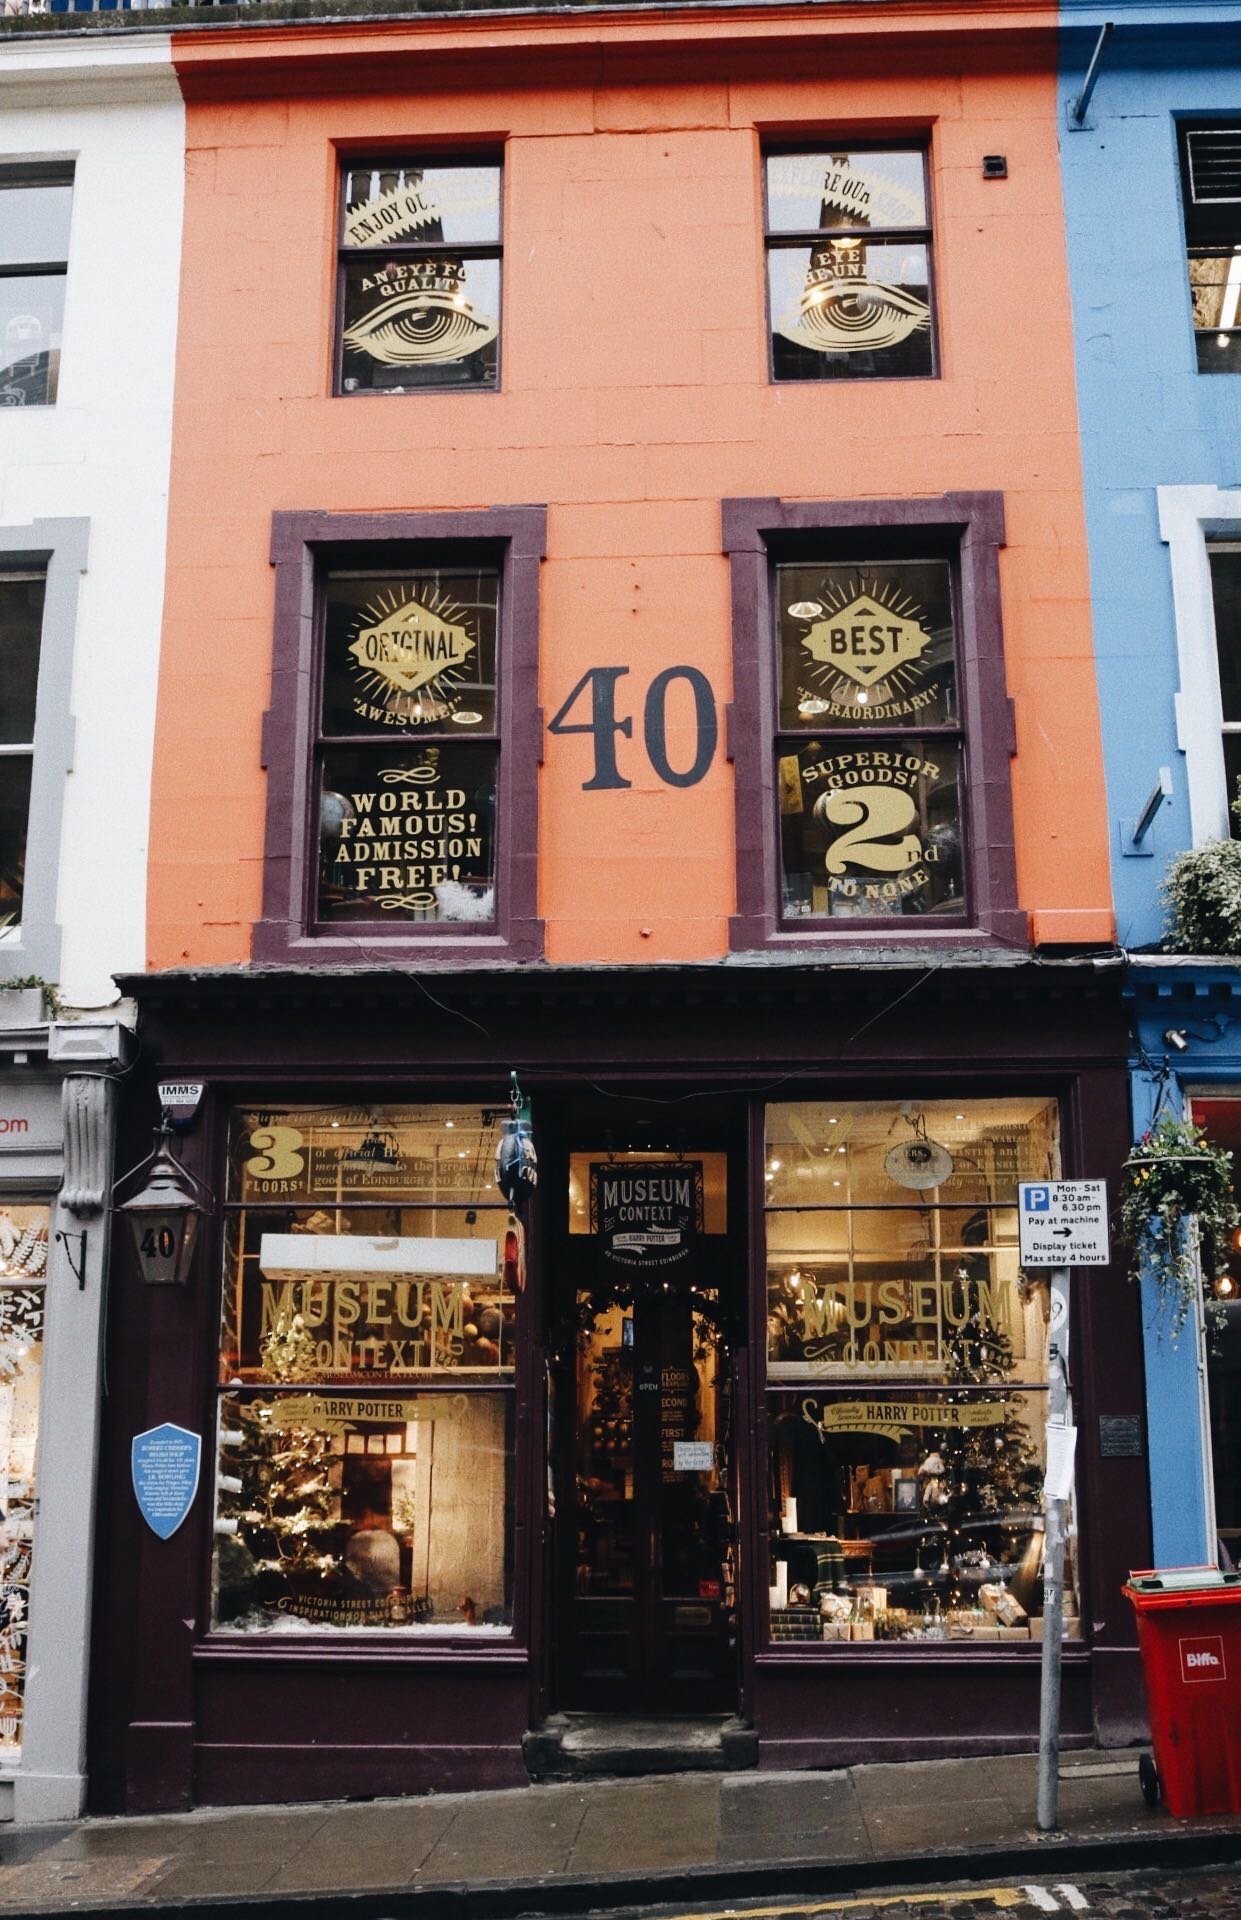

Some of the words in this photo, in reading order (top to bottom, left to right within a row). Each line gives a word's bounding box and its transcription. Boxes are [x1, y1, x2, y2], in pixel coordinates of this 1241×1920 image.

[348, 201, 408, 244] ENJOY
[817, 249, 860, 266] EYE
[361, 271, 390, 292] AN
[394, 263, 434, 279] EYE
[442, 263, 467, 280] FO
[365, 630, 460, 664] ORIGINAL
[830, 625, 903, 656] BEST
[547, 665, 718, 791] 40
[802, 752, 940, 784] SUPERIOR
[828, 768, 918, 789] GOODS!
[351, 789, 466, 813] WORLD
[340, 813, 478, 838] FAMOUS!
[335, 838, 482, 863] ADMISSION
[356, 864, 461, 891] FREE!
[828, 876, 857, 897] TO
[865, 869, 930, 899] NONE
[162, 1085, 198, 1095] IMMS
[247, 1126, 304, 1179] 3
[346, 1174, 358, 1185] of
[1057, 1185, 1077, 1193] Mon
[1084, 1184, 1100, 1192] Sat
[603, 1179, 690, 1210] MUSEUM
[1030, 1189, 1046, 1210] P
[1052, 1194, 1075, 1202] 8.30
[619, 1206, 673, 1221] CONTEXT
[1062, 1203, 1085, 1212] 6.30
[1086, 1204, 1101, 1213] pm
[1028, 1217, 1045, 1226] Pay
[1061, 1216, 1099, 1225] machine
[140, 1226, 175, 1259] 40
[1033, 1242, 1066, 1251] Display
[1070, 1242, 1097, 1250] ticket
[1048, 1254, 1066, 1263] stay
[1080, 1253, 1106, 1262] hours
[259, 1281, 465, 1340] MUSEUM
[801, 1280, 1012, 1339] MUSEUM
[842, 1340, 975, 1370] CONTEXT
[640, 1383, 659, 1391] OPEN
[357, 1402, 404, 1418] POTTER
[866, 1405, 908, 1421] HARRY
[912, 1406, 960, 1423] POTTER
[298, 1594, 338, 1608] VICTORIA
[341, 1599, 371, 1609] STREET
[1186, 1652, 1218, 1667] Biffa
